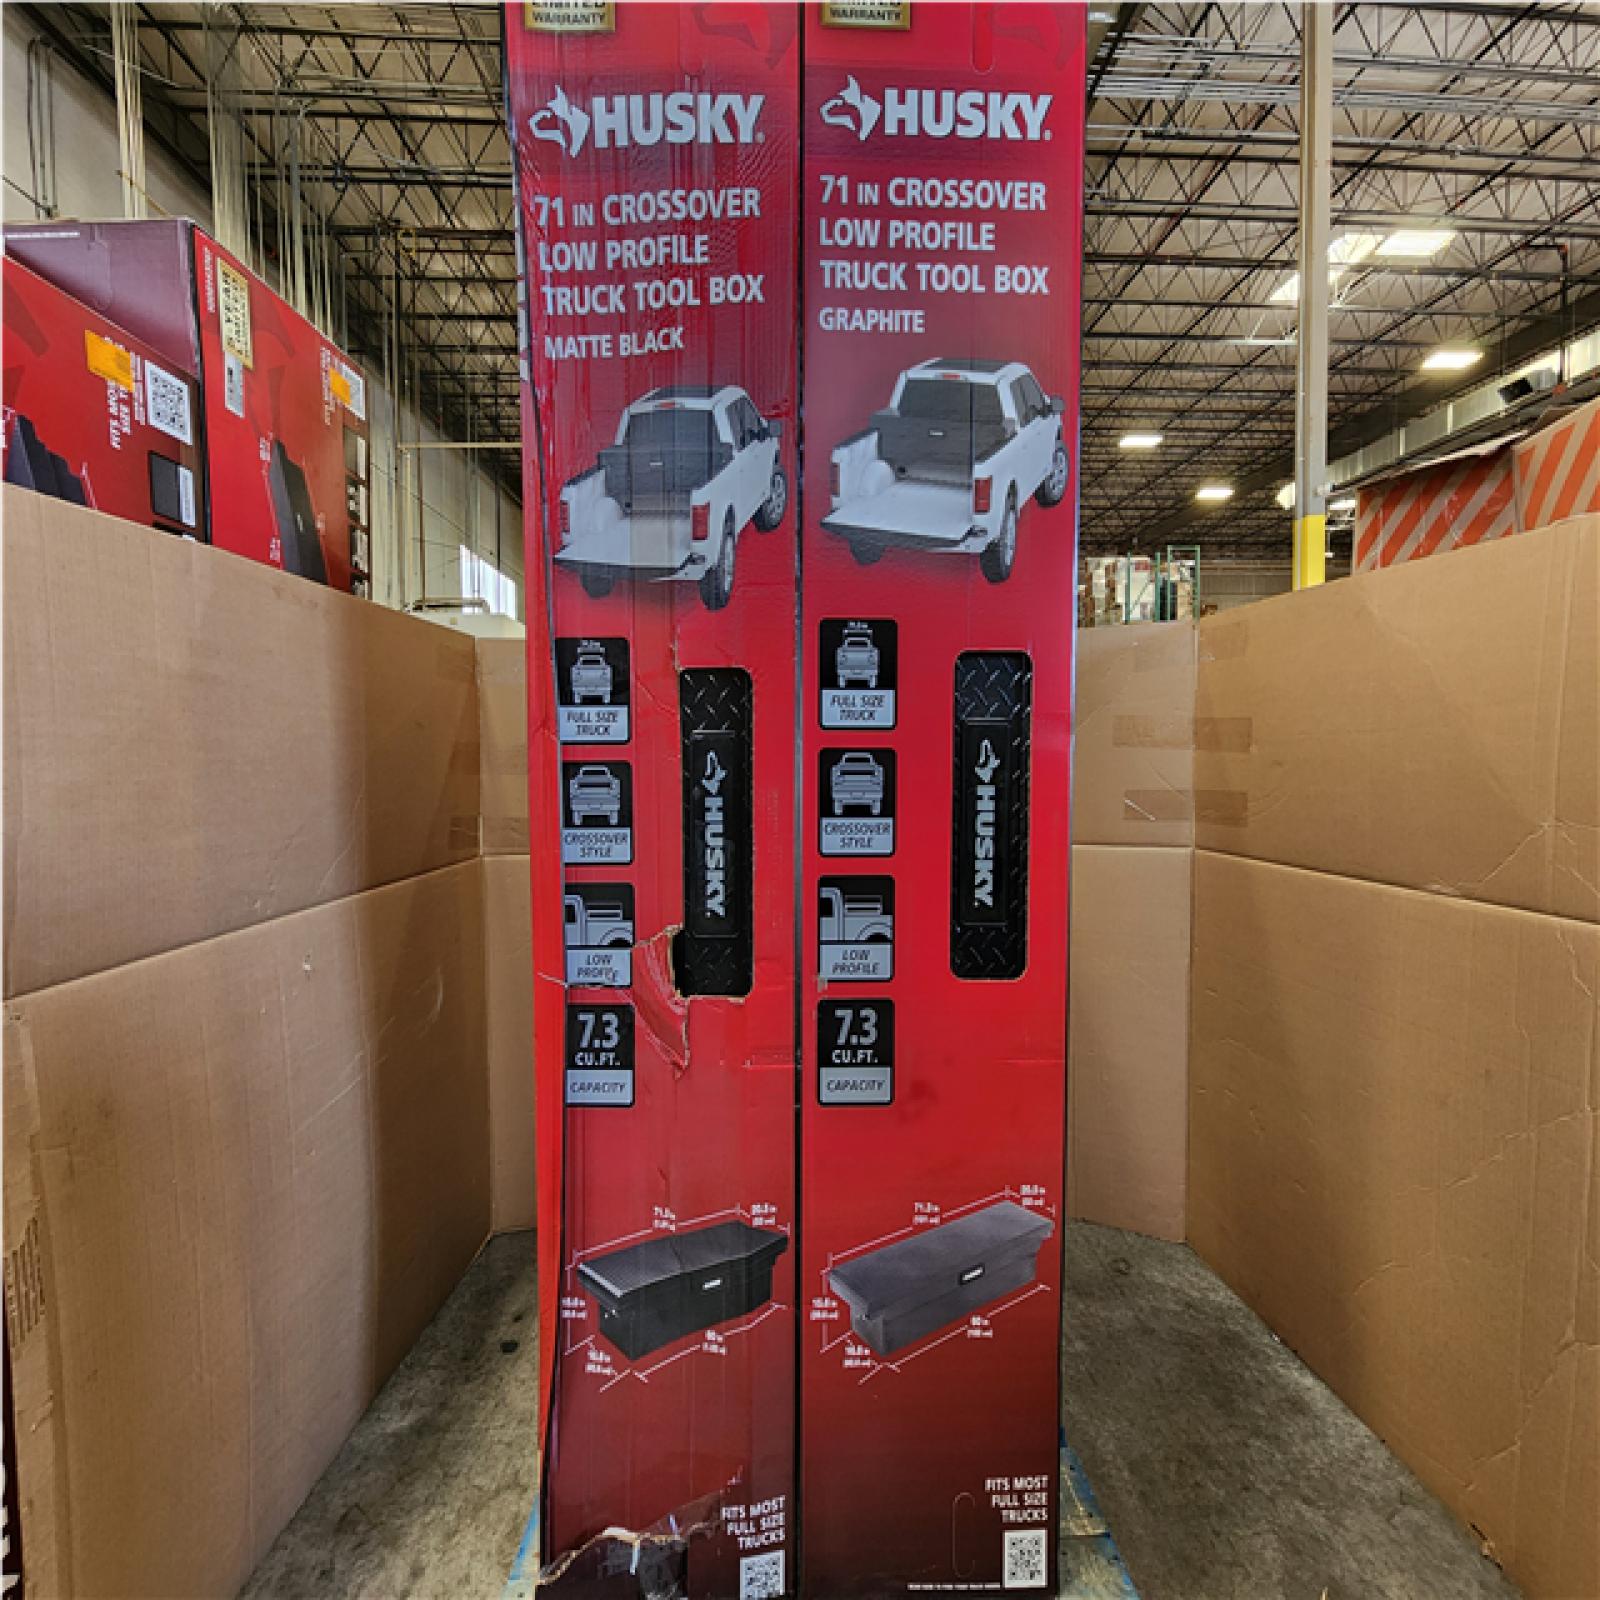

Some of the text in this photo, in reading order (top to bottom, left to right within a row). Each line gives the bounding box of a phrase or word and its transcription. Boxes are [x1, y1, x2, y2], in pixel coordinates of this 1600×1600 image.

[532, 12, 606, 24] WARRANTY
[829, 8, 901, 20] WARRANTY
[592, 92, 765, 148] HUSKY
[884, 88, 1052, 140] HUSKY
[819, 175, 1046, 211] 71 IN CROSSOVER
[534, 188, 761, 227] 71 IN CROSSOVER
[819, 217, 996, 251] LOW PROFILE
[538, 235, 711, 271] LOW PROFILE
[819, 260, 1049, 295] TRUCK TOOL BOX
[541, 275, 764, 315] TRUCK TOOL BOX
[819, 307, 925, 333] GRAPHITE
[544, 327, 684, 359] MATTE BLACK
[830, 695, 885, 707] FULL SIZE
[566, 711, 618, 723] FULL SIZE
[839, 709, 876, 721] TRUCK
[576, 724, 611, 736] TRUCK
[824, 822, 891, 836] CROSSOVER
[564, 832, 628, 845] CROSSOVER
[839, 836, 873, 849] STYLE
[579, 846, 611, 858] STYLE
[974, 785, 996, 908] HUSKY
[704, 797, 726, 918] HUSKY
[585, 954, 613, 965] LOW
[842, 949, 870, 961] LOW
[832, 962, 880, 975] PROFILE
[576, 1012, 620, 1049] 7.3
[834, 1007, 878, 1046] 7.3
[574, 1052, 621, 1066] CU.FT.
[831, 1050, 879, 1064] CU.FT.
[570, 1082, 625, 1094] CAPACITY
[826, 1079, 886, 1092] CAPACITY
[984, 1475, 1048, 1491] FITS MOST
[721, 1495, 786, 1520] FITS MOST
[991, 1492, 1048, 1508] FULL SIZE
[1002, 1508, 1048, 1523] TRUCKS
[727, 1520, 756, 1535] FULL
[737, 1527, 786, 1550] TRUCKS
